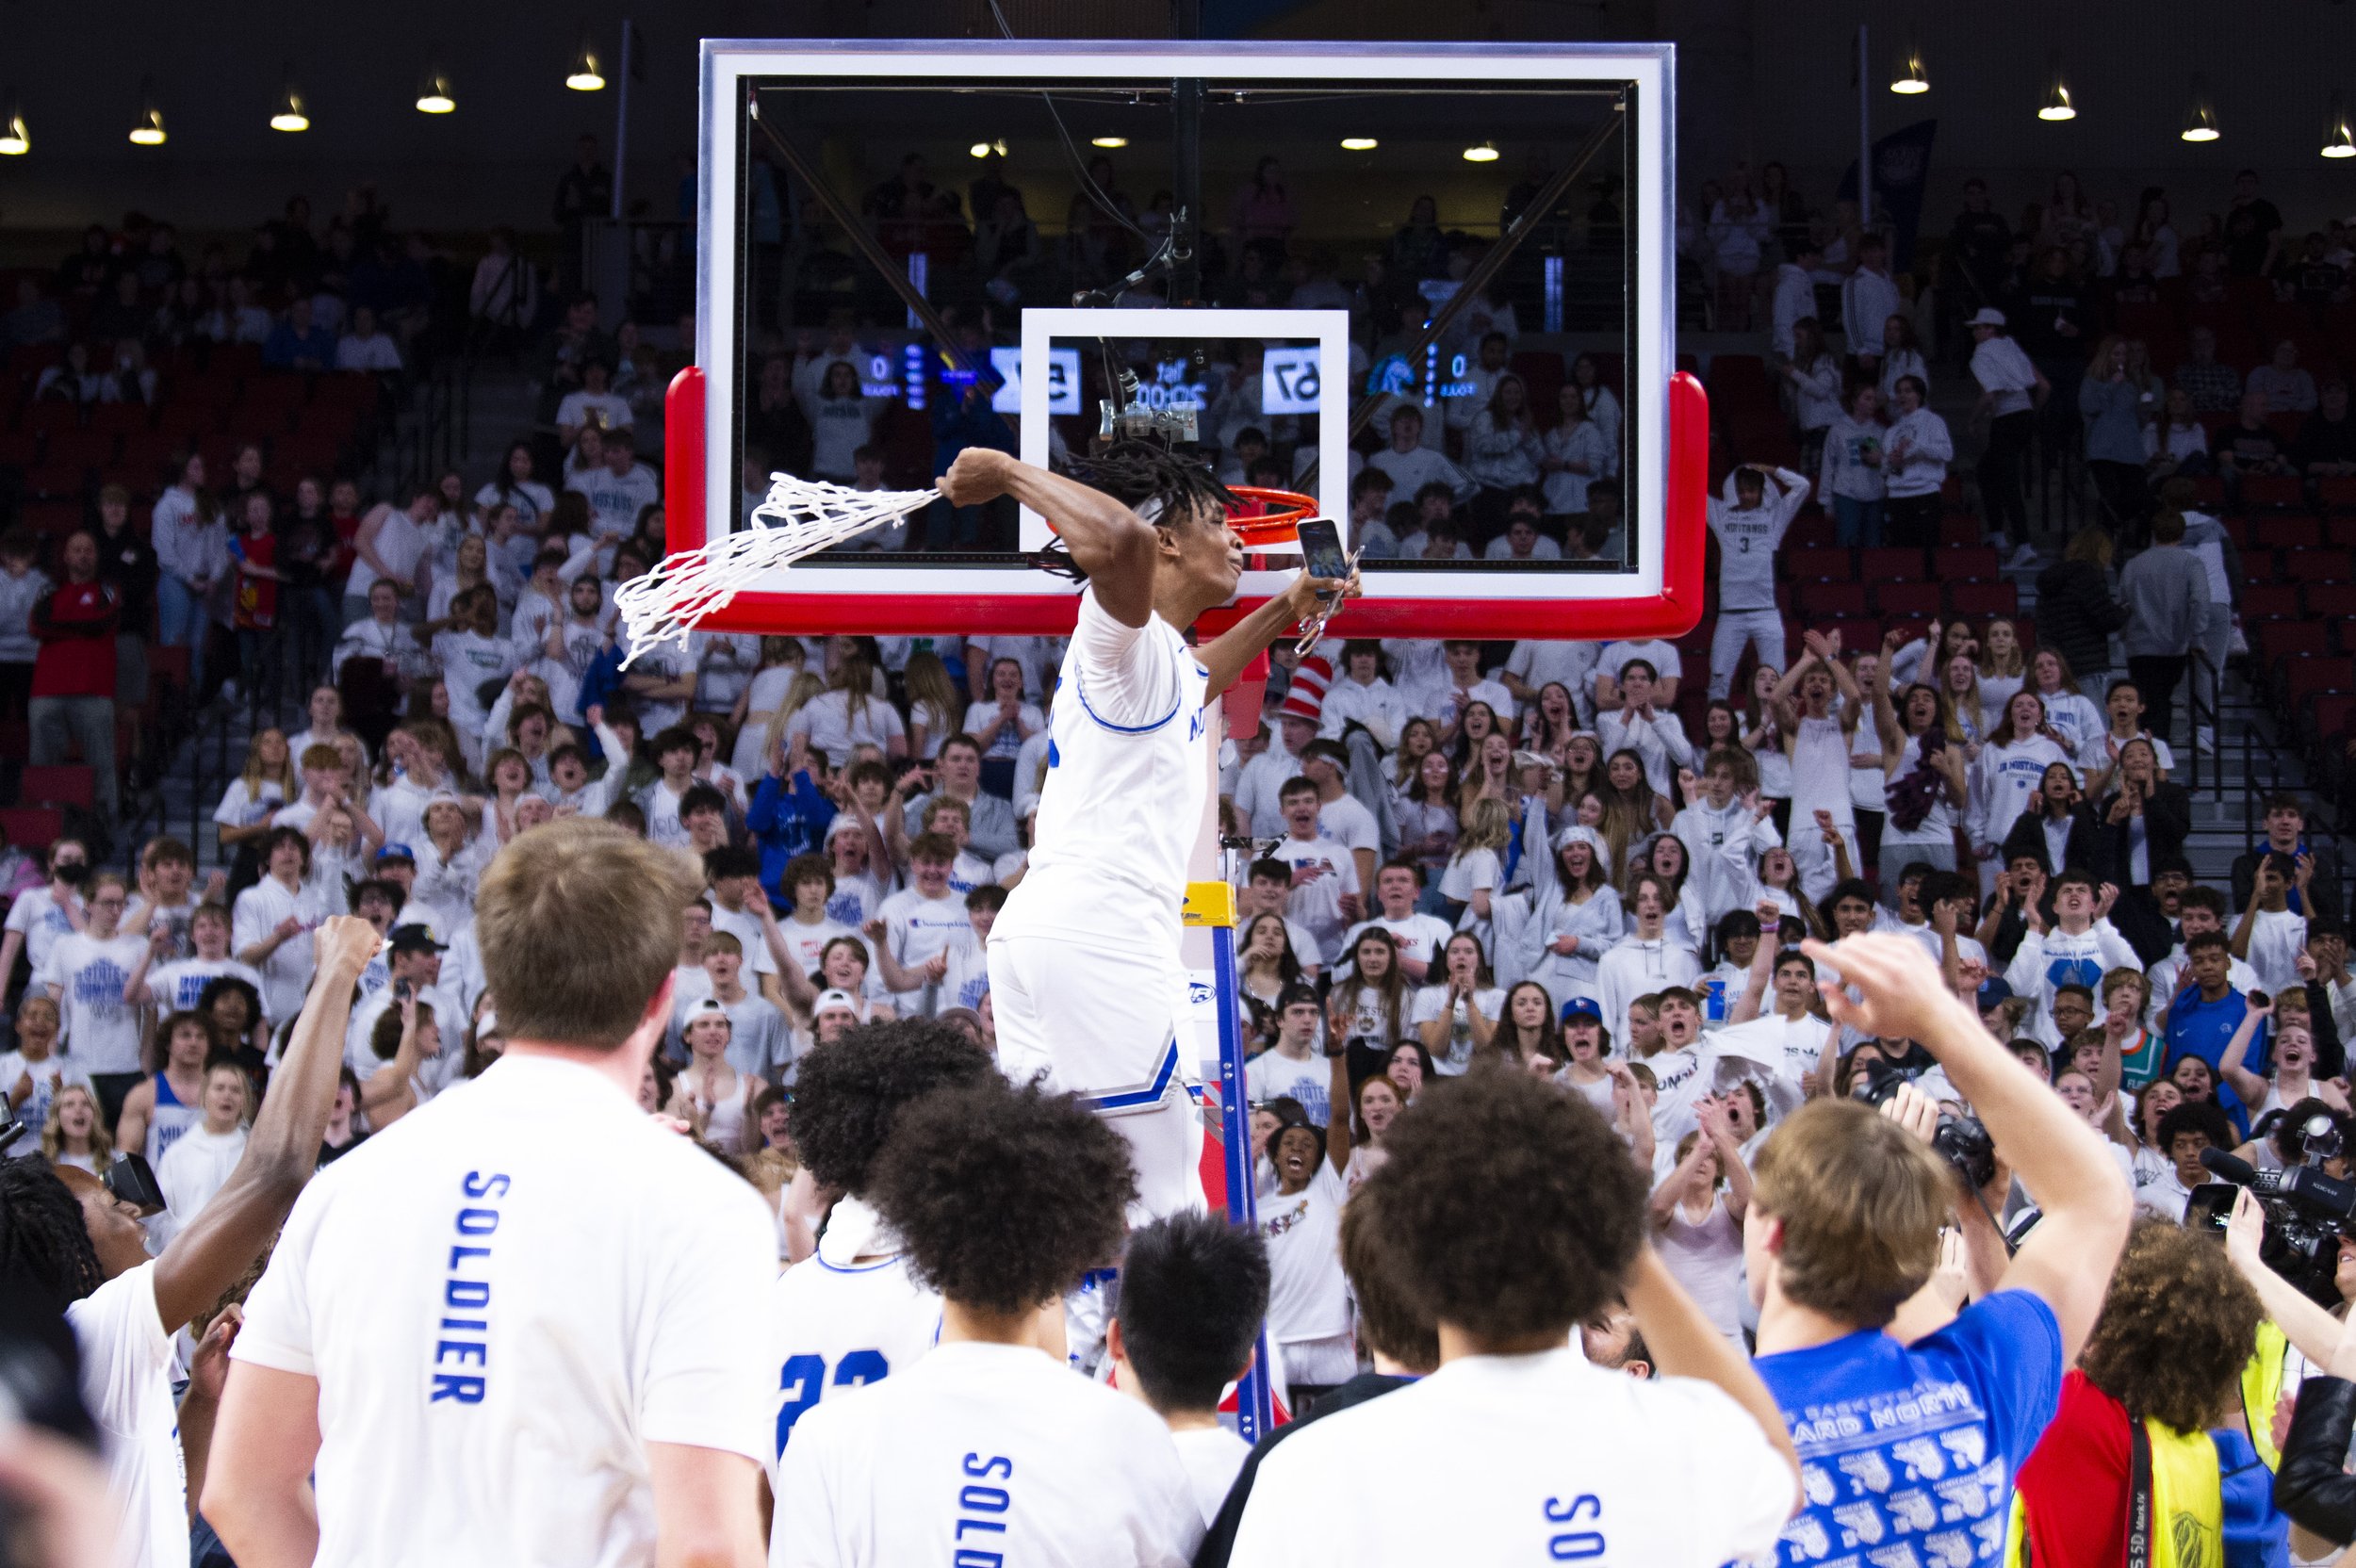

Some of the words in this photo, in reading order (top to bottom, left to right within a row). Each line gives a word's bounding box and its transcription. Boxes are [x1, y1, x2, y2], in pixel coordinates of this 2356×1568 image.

[1740, 538, 1750, 553] 3
[430, 1169, 511, 1405] SOLDIER
[1792, 1416, 1863, 1446] ARD
[2135, 1505, 2147, 1529] Mark
[2130, 1532, 2145, 1555] 5D
